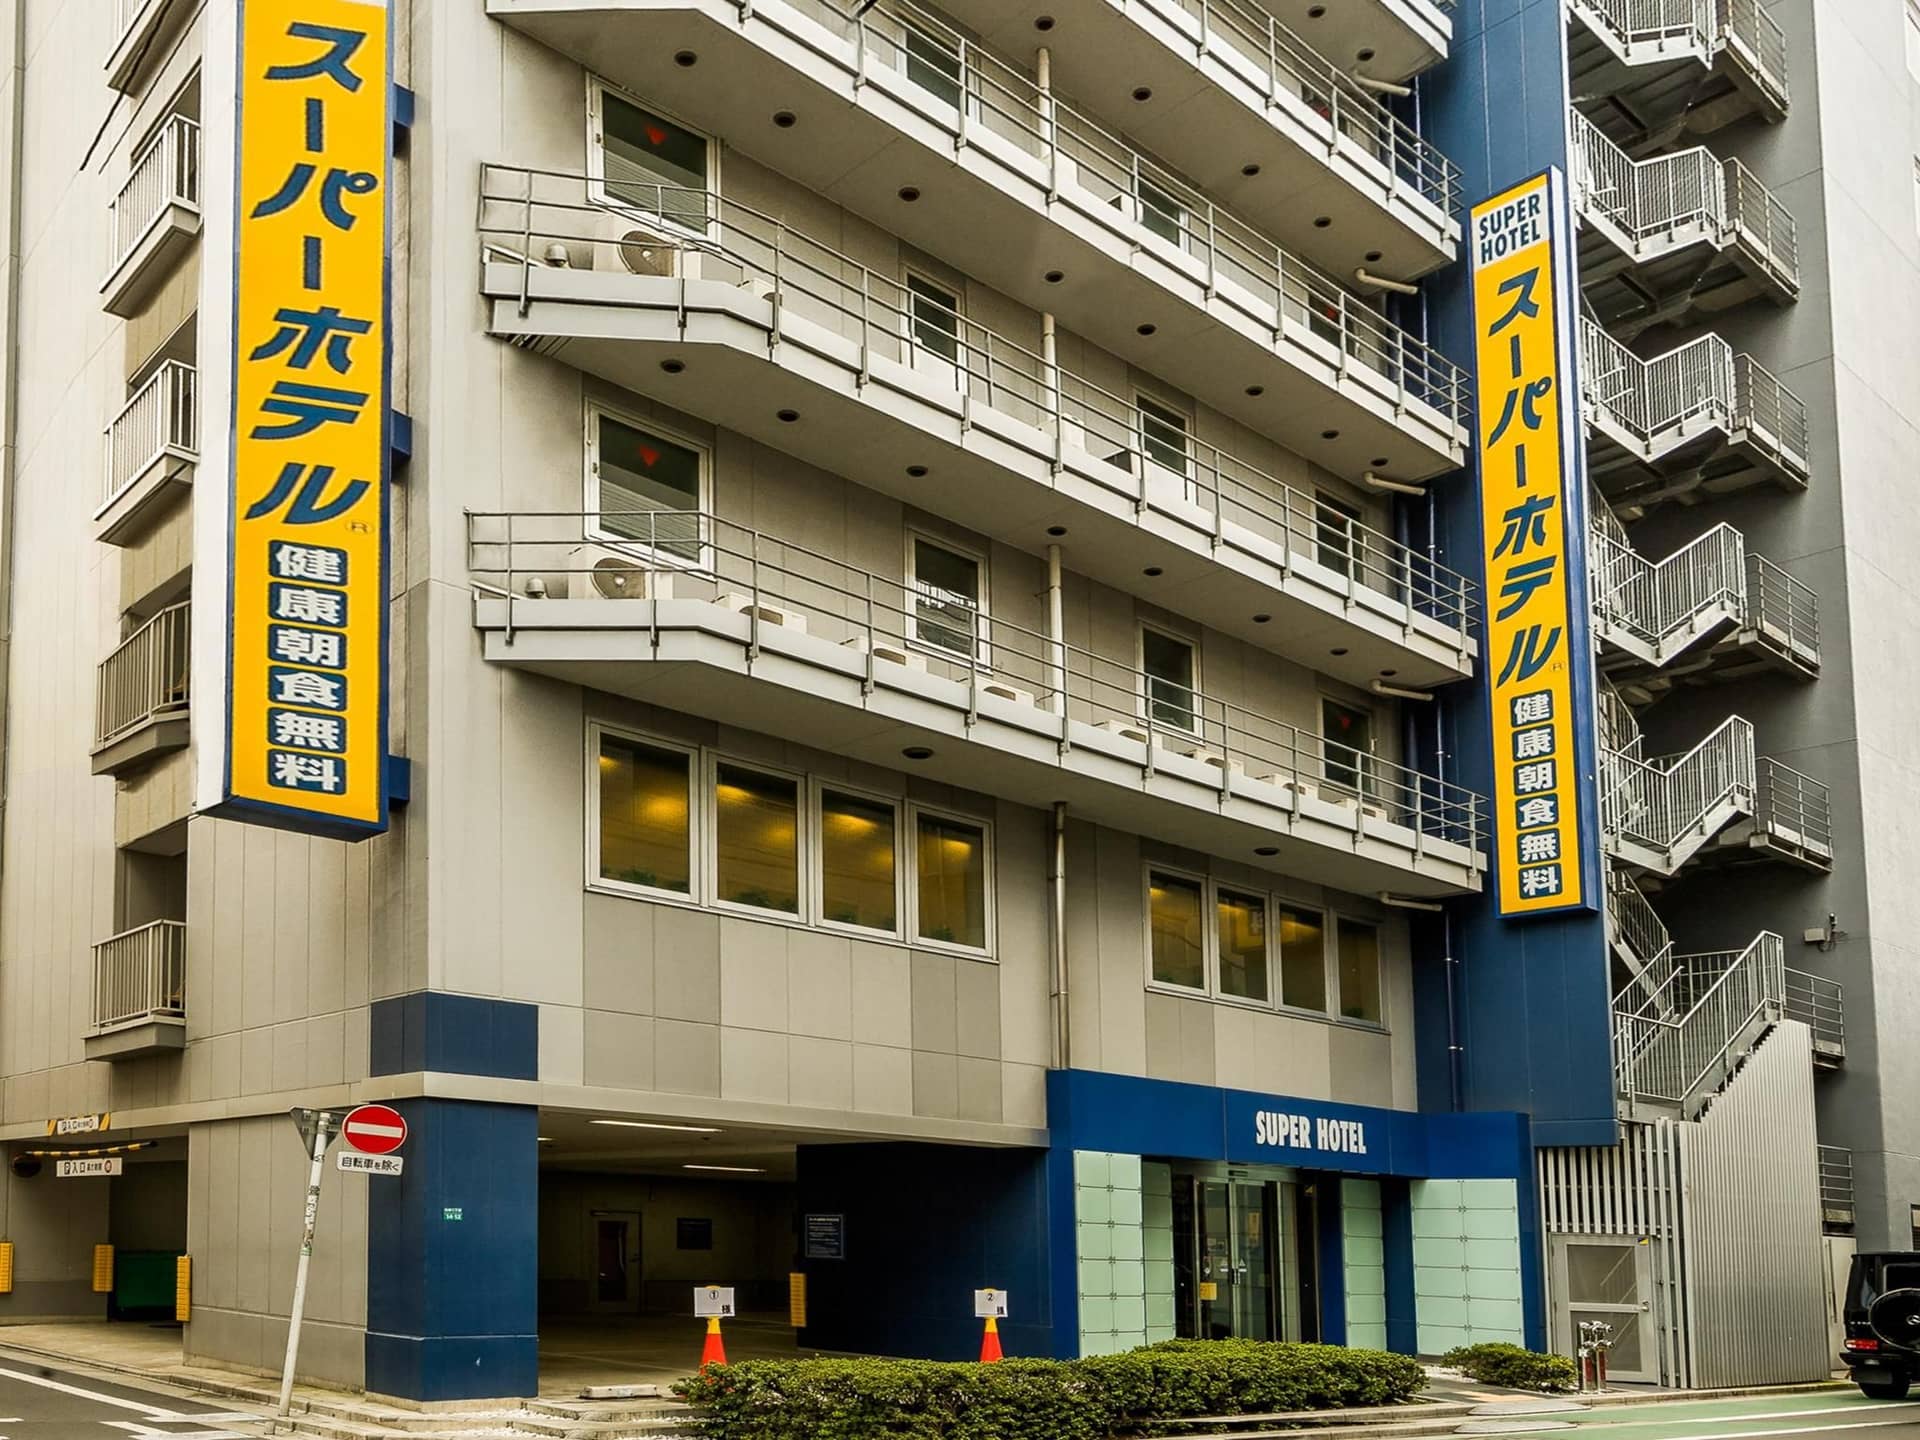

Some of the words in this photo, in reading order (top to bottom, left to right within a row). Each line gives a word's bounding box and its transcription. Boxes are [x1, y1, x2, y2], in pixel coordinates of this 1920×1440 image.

[244, 21, 379, 526] スーパーホテル
[1479, 193, 1541, 240] SUPER
[1481, 219, 1541, 264] HOTEL
[1487, 266, 1563, 689] スーパーホテル
[275, 544, 342, 792] 健康朝食無料
[1513, 692, 1560, 897] 健康朝食無料
[341, 1156, 400, 1171] 自転車を除く
[1255, 1110, 1312, 1149] SUPER
[1316, 1117, 1367, 1154] HOTEL
